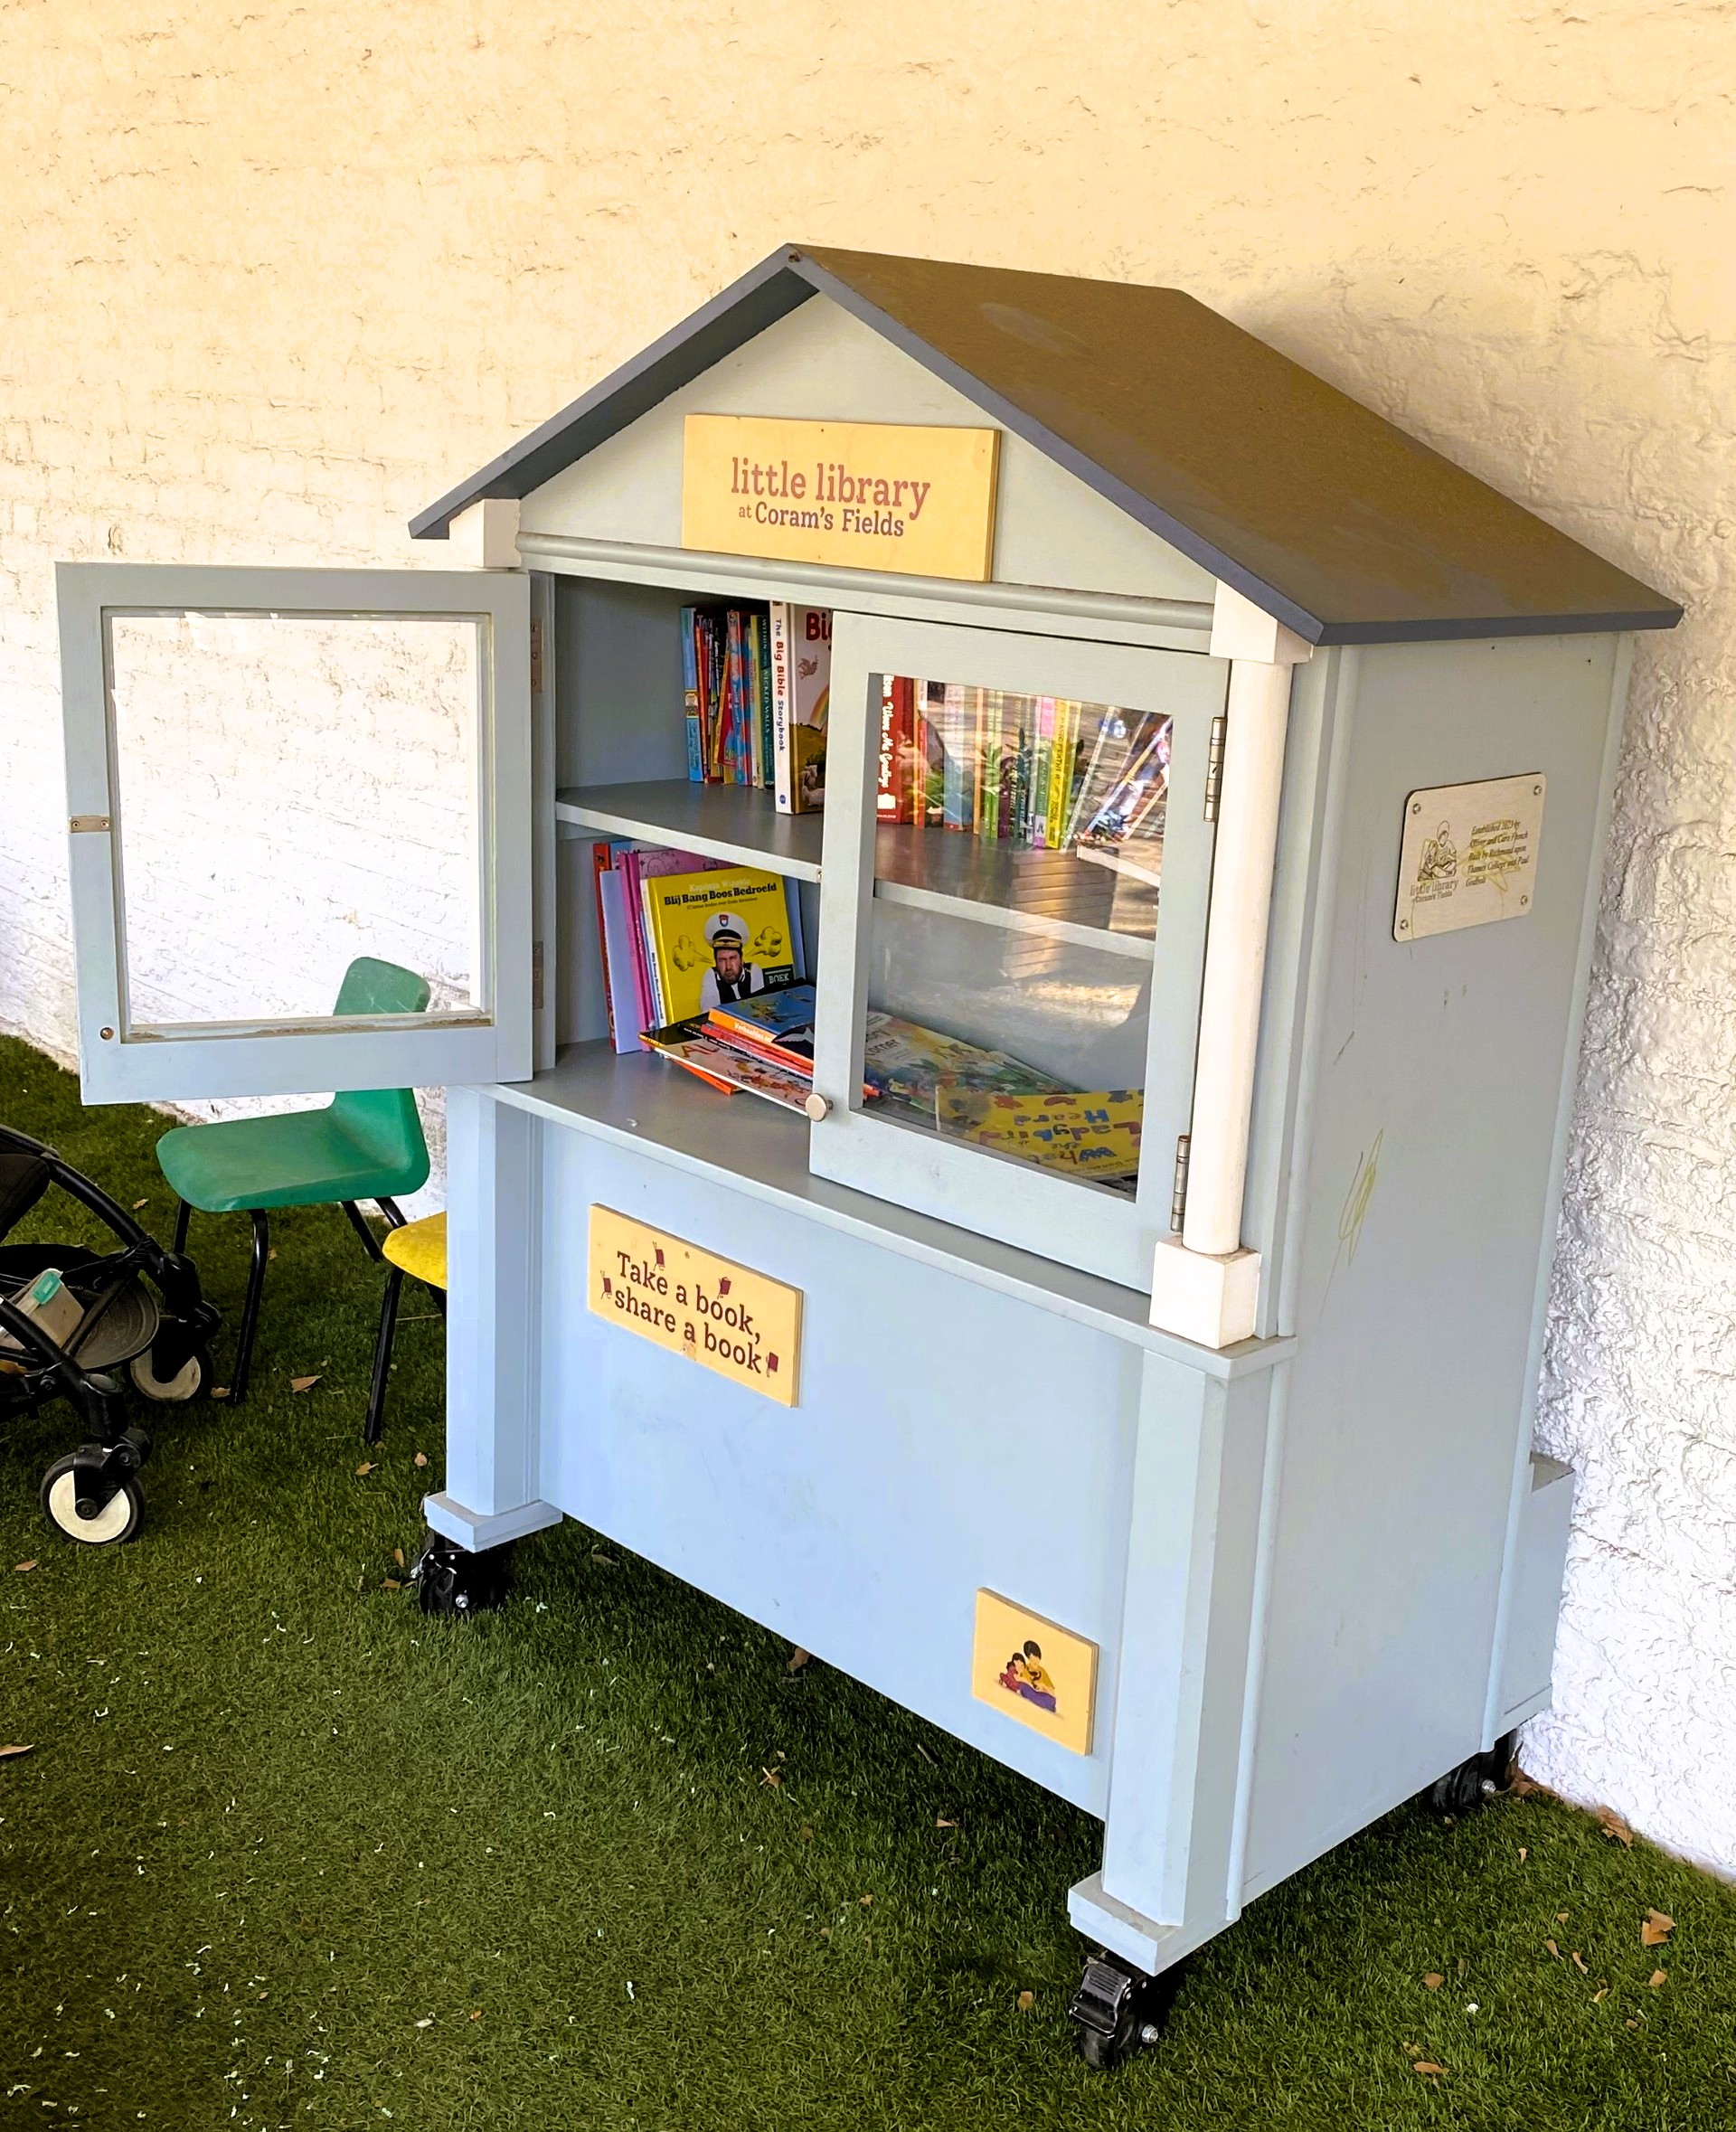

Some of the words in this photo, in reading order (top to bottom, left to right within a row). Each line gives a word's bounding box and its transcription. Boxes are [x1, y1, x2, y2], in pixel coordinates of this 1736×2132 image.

[731, 458, 807, 499] little
[816, 463, 930, 520] library
[739, 504, 752, 519] at
[755, 501, 834, 531] Coram's
[842, 509, 905, 537] Fields
[774, 641, 784, 661] Big
[776, 665, 785, 696] Bible
[776, 700, 786, 751] Storybook
[664, 895, 681, 906] Blij
[682, 892, 708, 903] Bang
[709, 890, 733, 900] Boos
[733, 882, 777, 896] Bedroefd
[1410, 882, 1430, 896] little
[1431, 879, 1458, 893] library
[978, 1121, 1141, 1146] Ladybird
[1013, 1109, 1109, 1127] Heard
[617, 1250, 668, 1296] Take
[675, 1285, 688, 1306] a
[695, 1284, 760, 1344] book,
[615, 1287, 675, 1333] share
[684, 1322, 696, 1343] a
[704, 1322, 761, 1374] book
